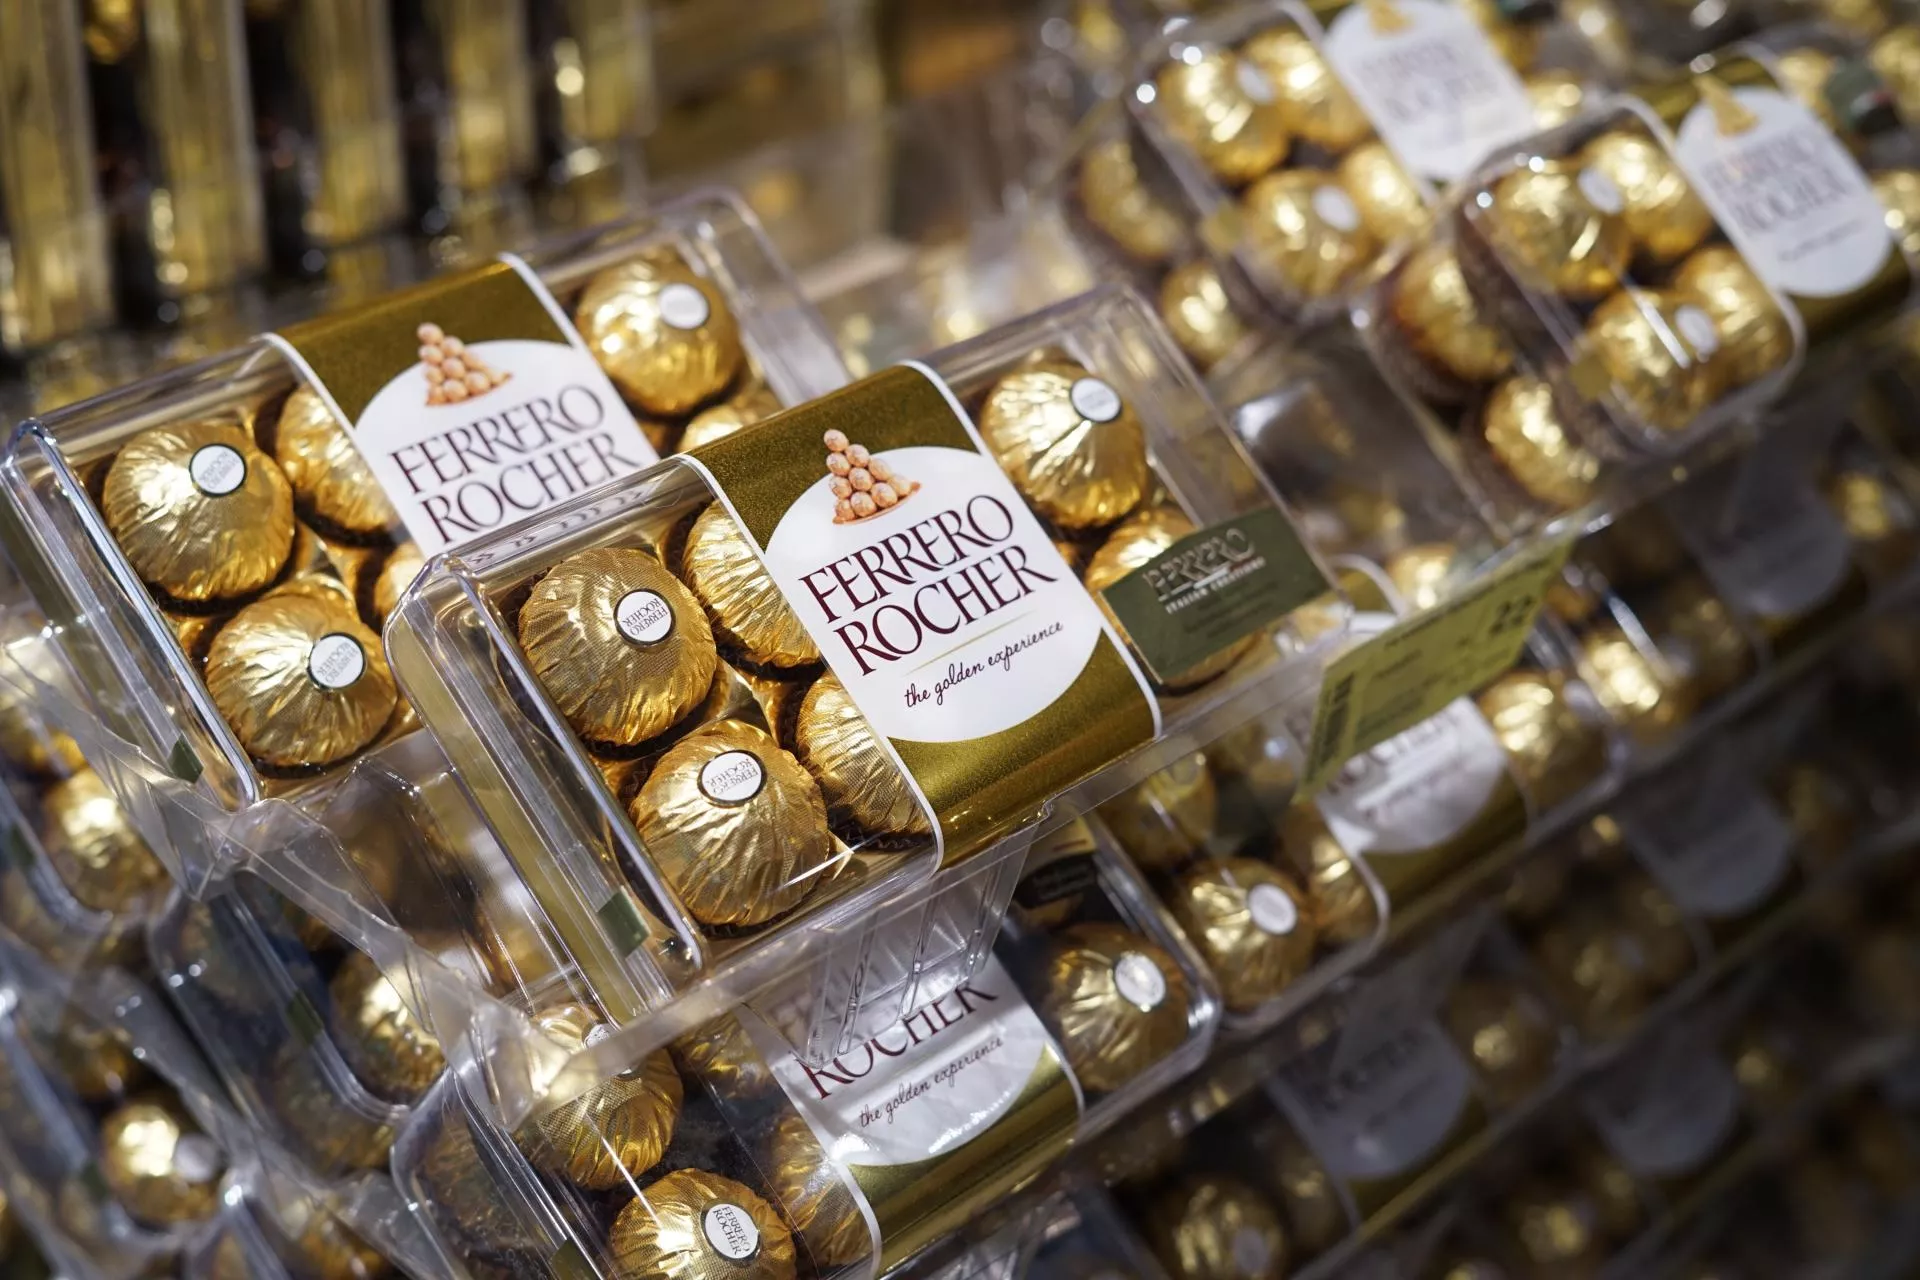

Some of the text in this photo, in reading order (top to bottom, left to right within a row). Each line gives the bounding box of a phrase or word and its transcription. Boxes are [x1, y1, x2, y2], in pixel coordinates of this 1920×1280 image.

[389, 384, 605, 494] FERRERO
[419, 432, 643, 543] ROCHER
[798, 494, 1014, 624] FERRERO
[621, 598, 661, 627] ROCHER
[630, 606, 668, 636] FERRERO
[833, 545, 1058, 677] ROCHER
[904, 621, 1063, 708] the golden experience
[860, 1037, 1004, 1127] the golden experience
[712, 1209, 741, 1256] ROCHER
[721, 1206, 751, 1252] FERRERO
